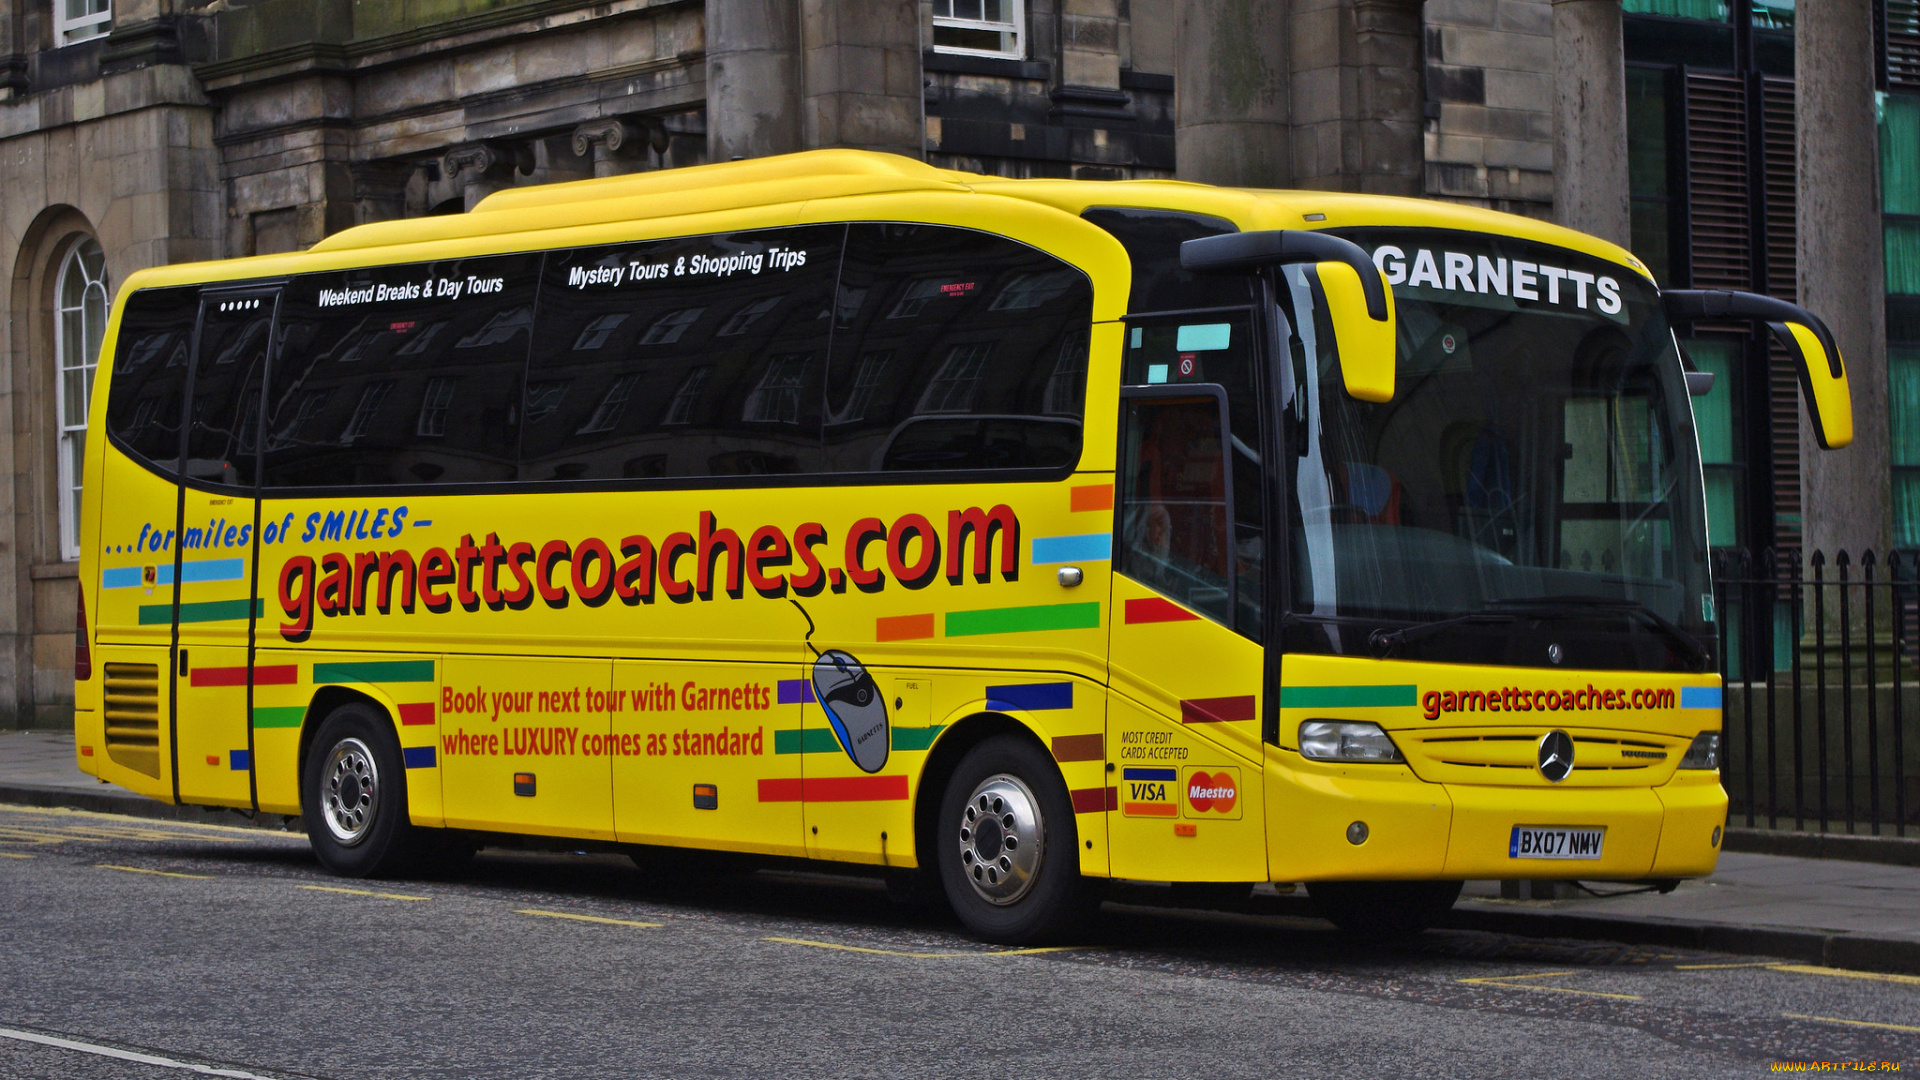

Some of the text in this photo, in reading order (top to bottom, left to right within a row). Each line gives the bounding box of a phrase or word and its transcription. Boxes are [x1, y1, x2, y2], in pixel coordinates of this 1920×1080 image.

[568, 247, 807, 289] Mystery Tours & Shopping Trips
[1372, 245, 1623, 315] GARNETTS
[318, 275, 504, 307] Weekend Breaks & Day Tours
[182, 518, 252, 549] miles
[263, 512, 294, 545] of
[301, 505, 408, 543] SMILES
[278, 503, 1020, 643] garnettscoaches.com
[906, 682, 919, 690] FUEL
[442, 681, 770, 723] Book your next tour with Garnetts
[1422, 684, 1675, 721] garnettscoaches.com
[442, 726, 763, 757] where LUXURY comes as standard
[857, 722, 884, 745] GARNETTS
[1121, 731, 1173, 744] MOST CREDIT
[1121, 747, 1189, 759] CARDS ACCEPTED
[1130, 783, 1166, 801] VISA
[1189, 785, 1235, 799] Maestro
[1520, 831, 1601, 855] BX07 NMV
